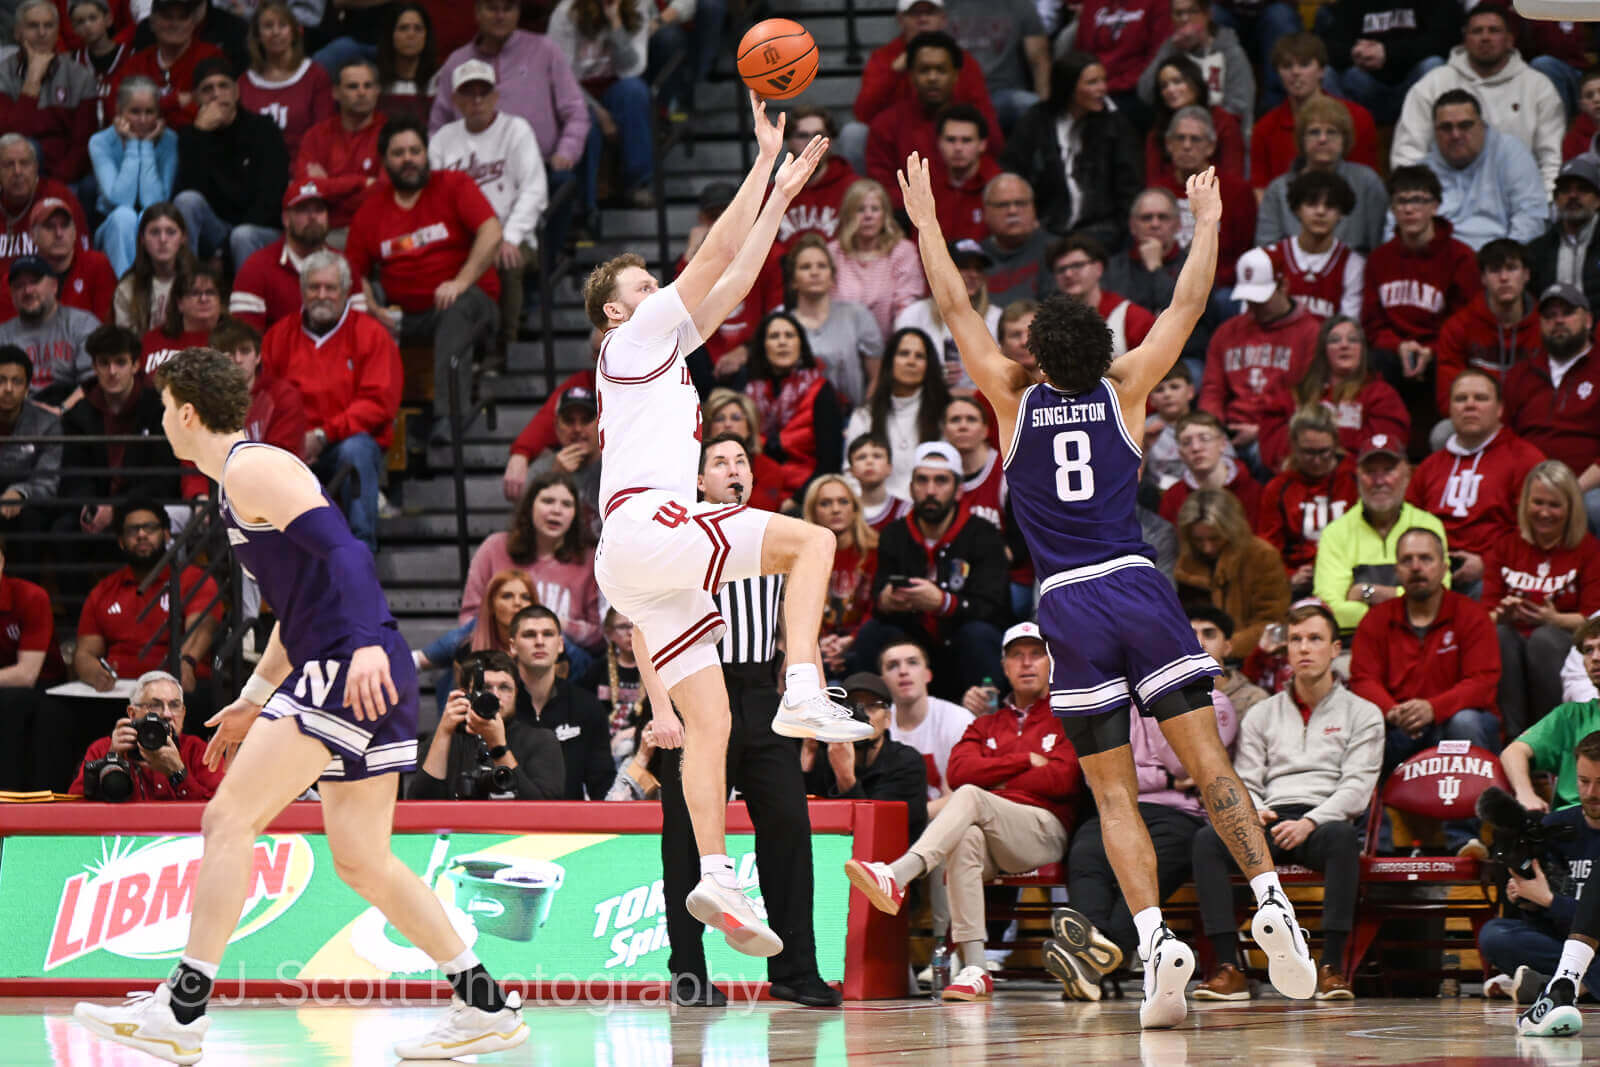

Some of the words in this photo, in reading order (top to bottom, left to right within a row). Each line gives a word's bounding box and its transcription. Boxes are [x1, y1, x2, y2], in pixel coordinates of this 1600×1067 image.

[1031, 401, 1106, 428] SINGLETON
[1052, 430, 1096, 503] 8
[1403, 756, 1495, 782] INDIANA
[48, 842, 292, 967] LIBMN
